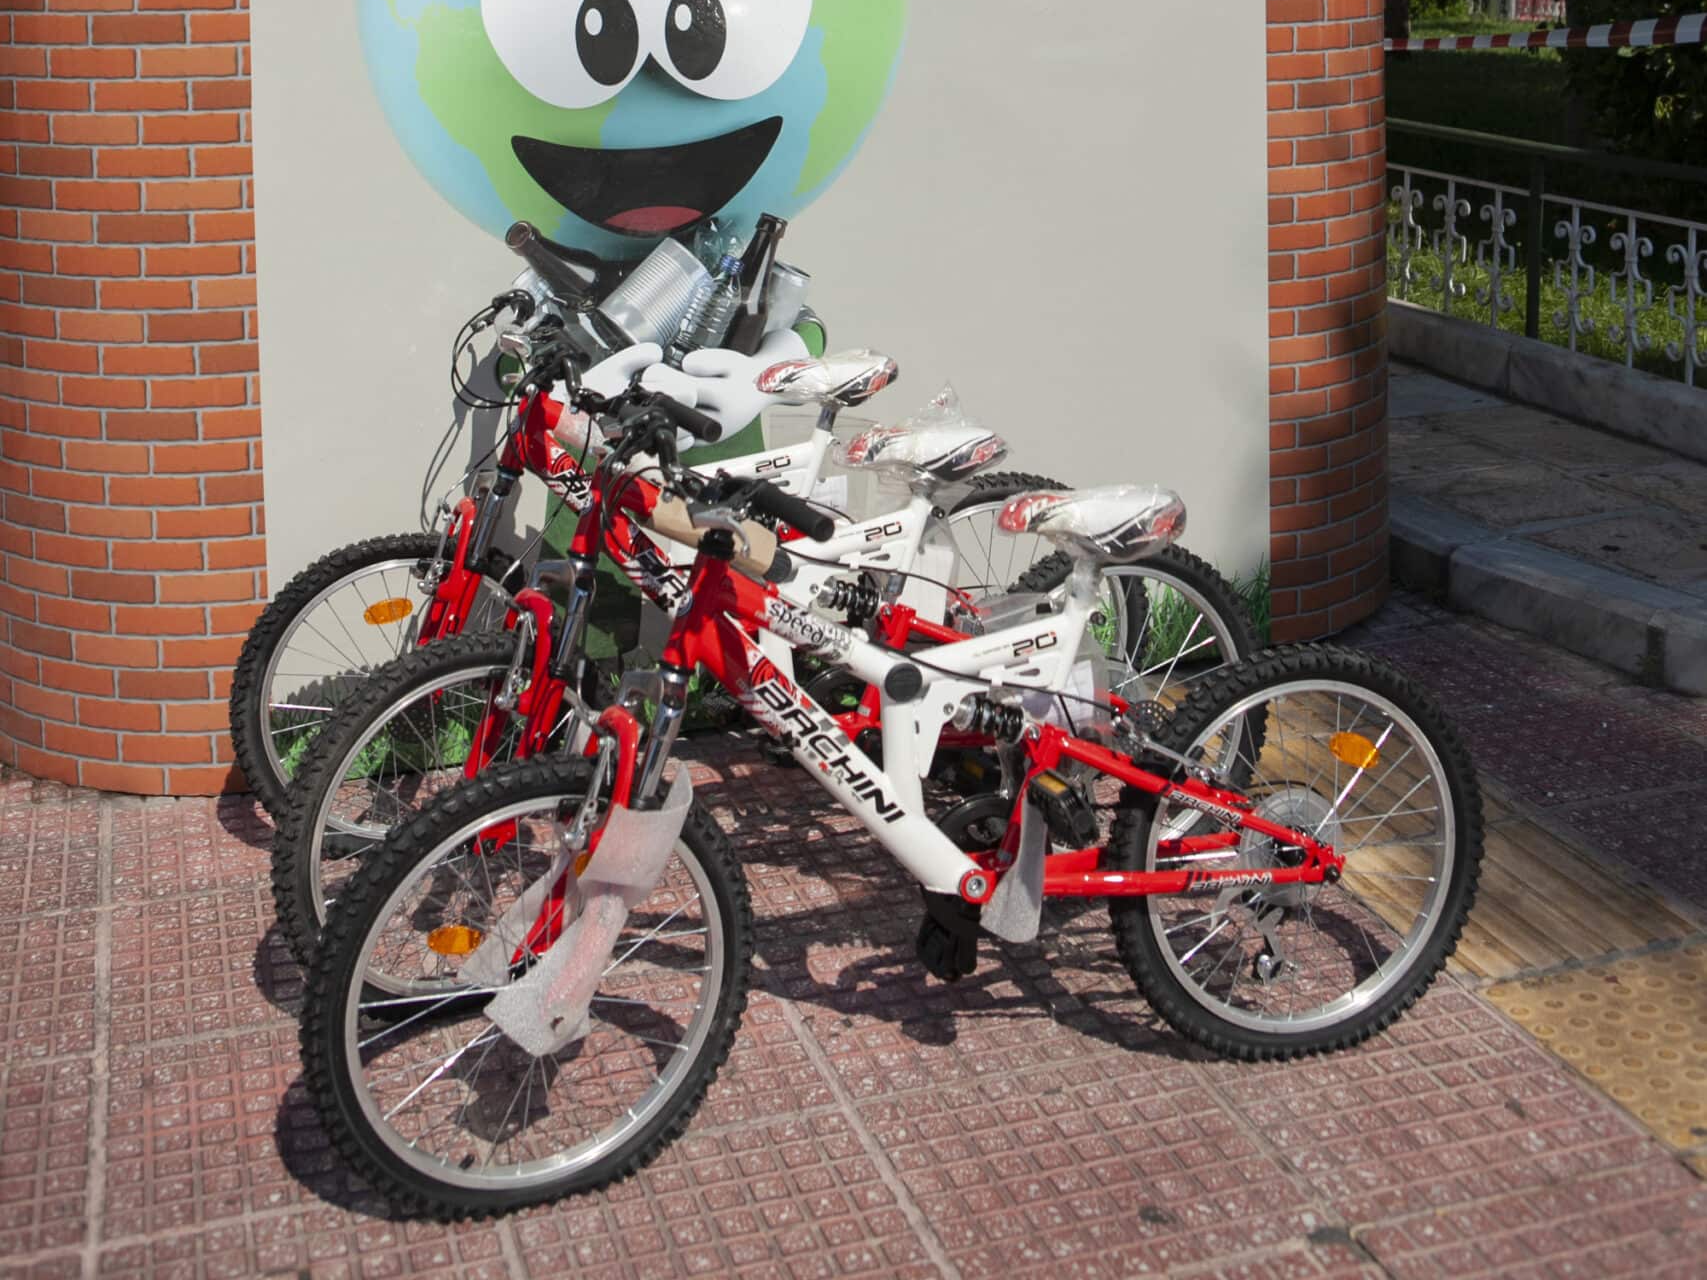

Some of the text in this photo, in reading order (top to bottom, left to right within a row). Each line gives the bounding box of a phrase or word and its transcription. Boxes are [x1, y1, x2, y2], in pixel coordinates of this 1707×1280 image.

[755, 455, 792, 473] 20
[863, 521, 902, 542] 20
[1012, 631, 1057, 657] 20
[755, 680, 906, 824] BACHINI
